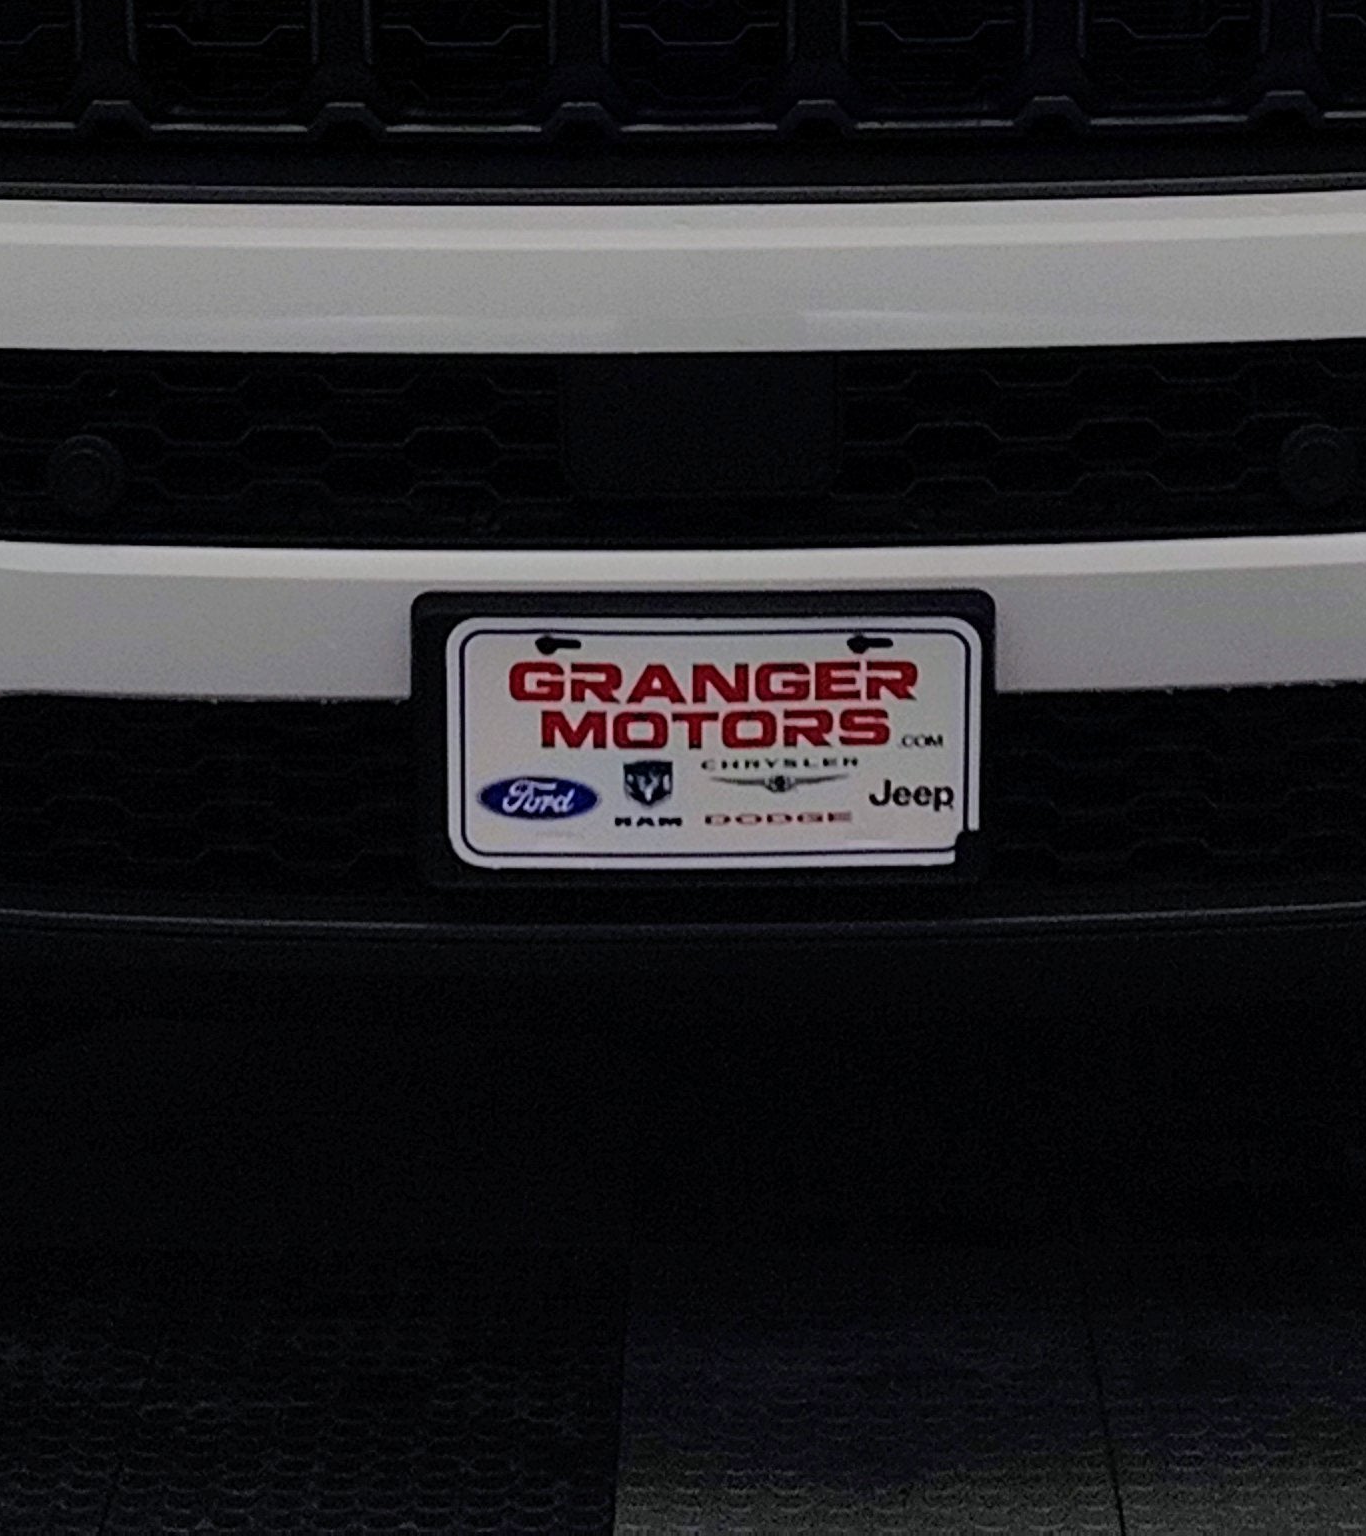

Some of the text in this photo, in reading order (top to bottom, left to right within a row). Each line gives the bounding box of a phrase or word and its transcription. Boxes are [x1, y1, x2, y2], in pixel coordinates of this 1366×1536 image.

[509, 661, 918, 704] GRANGER
[540, 709, 890, 750] MOTORS
[701, 757, 859, 770] CHRYSLER
[501, 779, 575, 814] Ford
[869, 779, 955, 811] Jeep
[614, 816, 683, 828] RAM
[704, 811, 853, 826] DODGE
